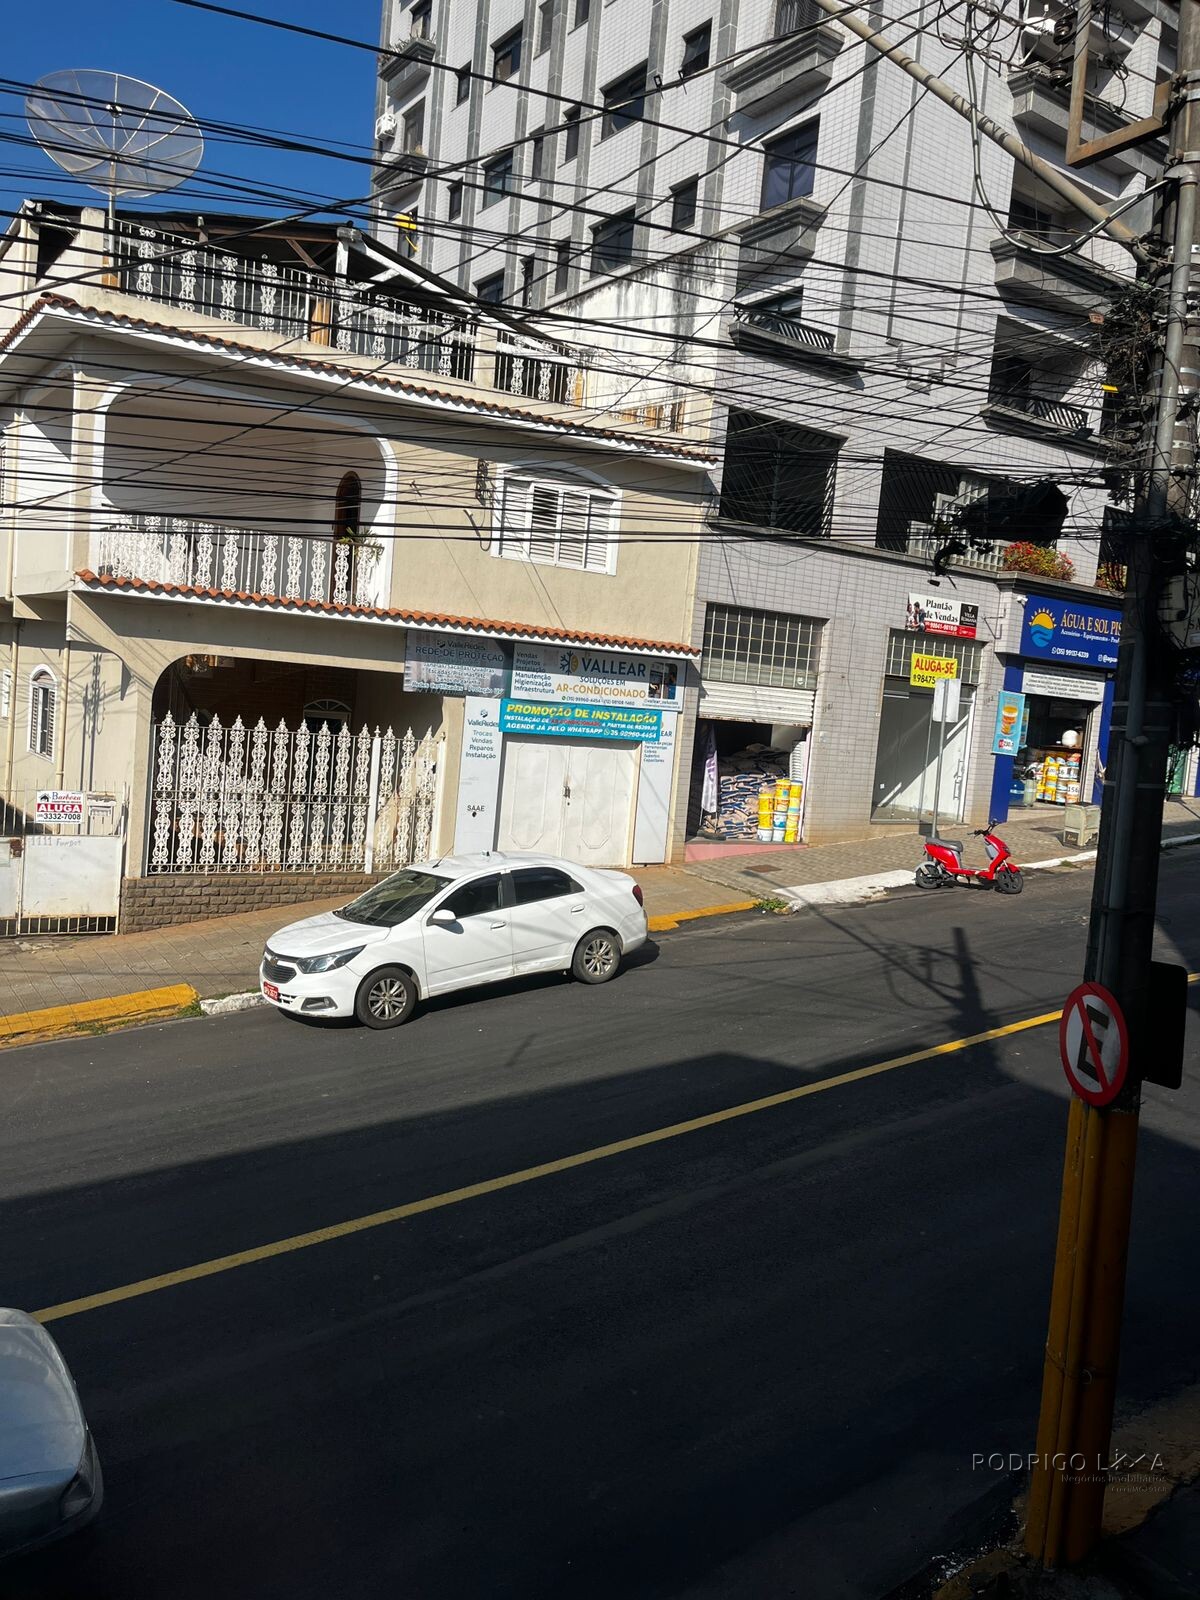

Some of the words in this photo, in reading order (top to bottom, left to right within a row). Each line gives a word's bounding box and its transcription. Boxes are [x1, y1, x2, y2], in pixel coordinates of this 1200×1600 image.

[926, 599, 952, 610] Plantão
[934, 612, 958, 622] Vendas
[1060, 609, 1085, 630] ÁGUA
[1087, 617, 1093, 631] E
[1094, 619, 1109, 634] SOL
[416, 646, 440, 656] REDE
[443, 648, 455, 657] DE
[458, 650, 504, 662] PROTEÇÃO
[516, 665, 546, 673] Instalação
[582, 658, 646, 677] VALLEAR
[914, 658, 954, 674] ALUGA-SE
[515, 672, 552, 680] Manutenção
[580, 676, 614, 686] SOLUÇÕES
[514, 679, 552, 688] Higienização
[514, 686, 554, 694] Infraestrutura
[556, 684, 646, 698] AR-CONDICIONADO
[504, 714, 540, 723] INSTALAÇÃO
[506, 704, 572, 718] PROMOÇÃO
[575, 708, 588, 718] DE
[592, 710, 657, 724] INSTALAÇÃO
[567, 726, 603, 734] WHATSAPP
[38, 804, 80, 812] ALUGA
